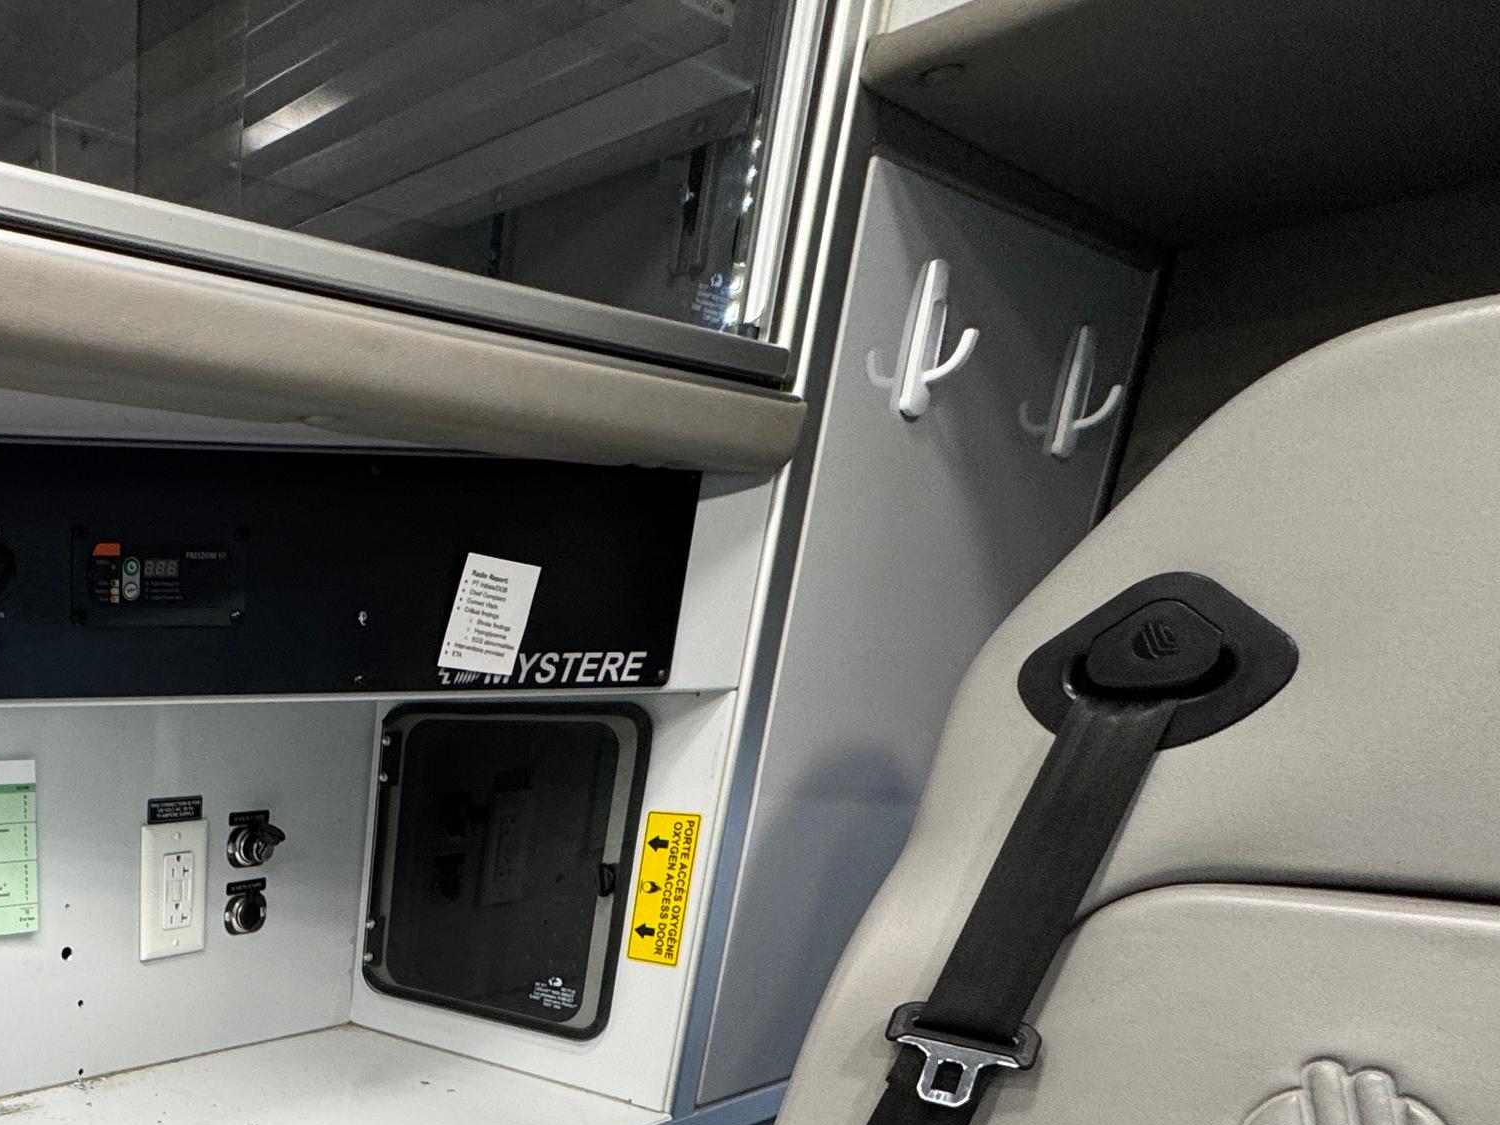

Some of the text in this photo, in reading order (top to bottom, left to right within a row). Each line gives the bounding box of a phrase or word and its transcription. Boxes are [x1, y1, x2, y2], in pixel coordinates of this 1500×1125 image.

[471, 569, 488, 579] Radio
[680, 819, 696, 861] PORTE
[653, 821, 683, 956] OXYGEN ACCESS DOOR
